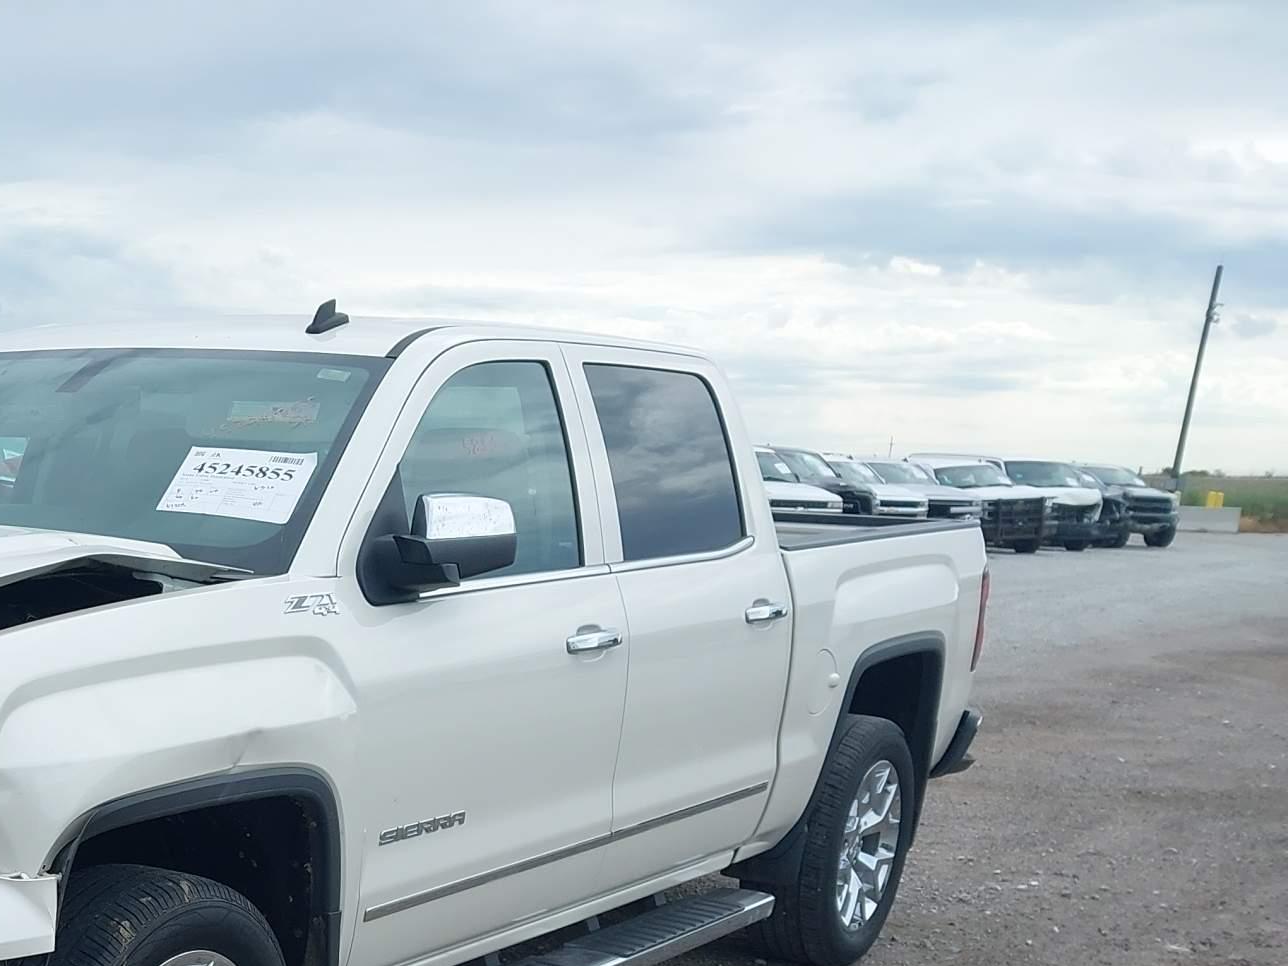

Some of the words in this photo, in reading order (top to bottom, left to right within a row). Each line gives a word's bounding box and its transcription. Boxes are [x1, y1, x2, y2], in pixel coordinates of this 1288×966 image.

[193, 461, 297, 482] 45245855
[284, 592, 337, 614] Z71
[379, 810, 465, 846] SIERRA
